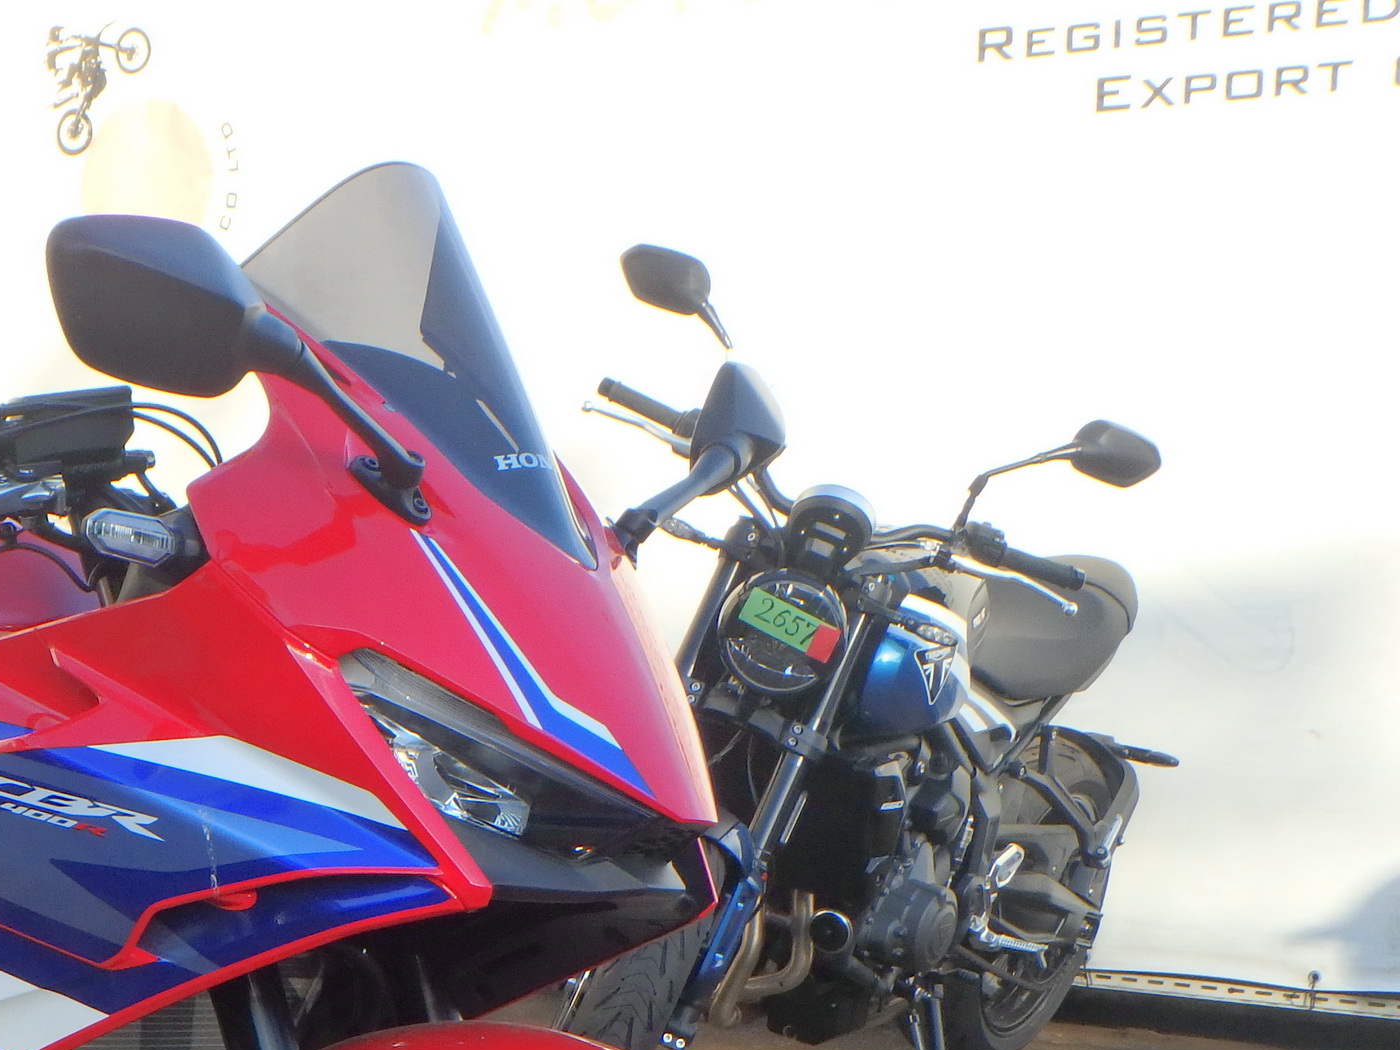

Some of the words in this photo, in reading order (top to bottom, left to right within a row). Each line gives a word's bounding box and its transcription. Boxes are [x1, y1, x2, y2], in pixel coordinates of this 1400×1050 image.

[976, 0, 1400, 62] REGISTERED
[1096, 60, 1354, 112] EXPORT
[754, 597, 820, 646] 2657
[0, 802, 108, 838] 400R
